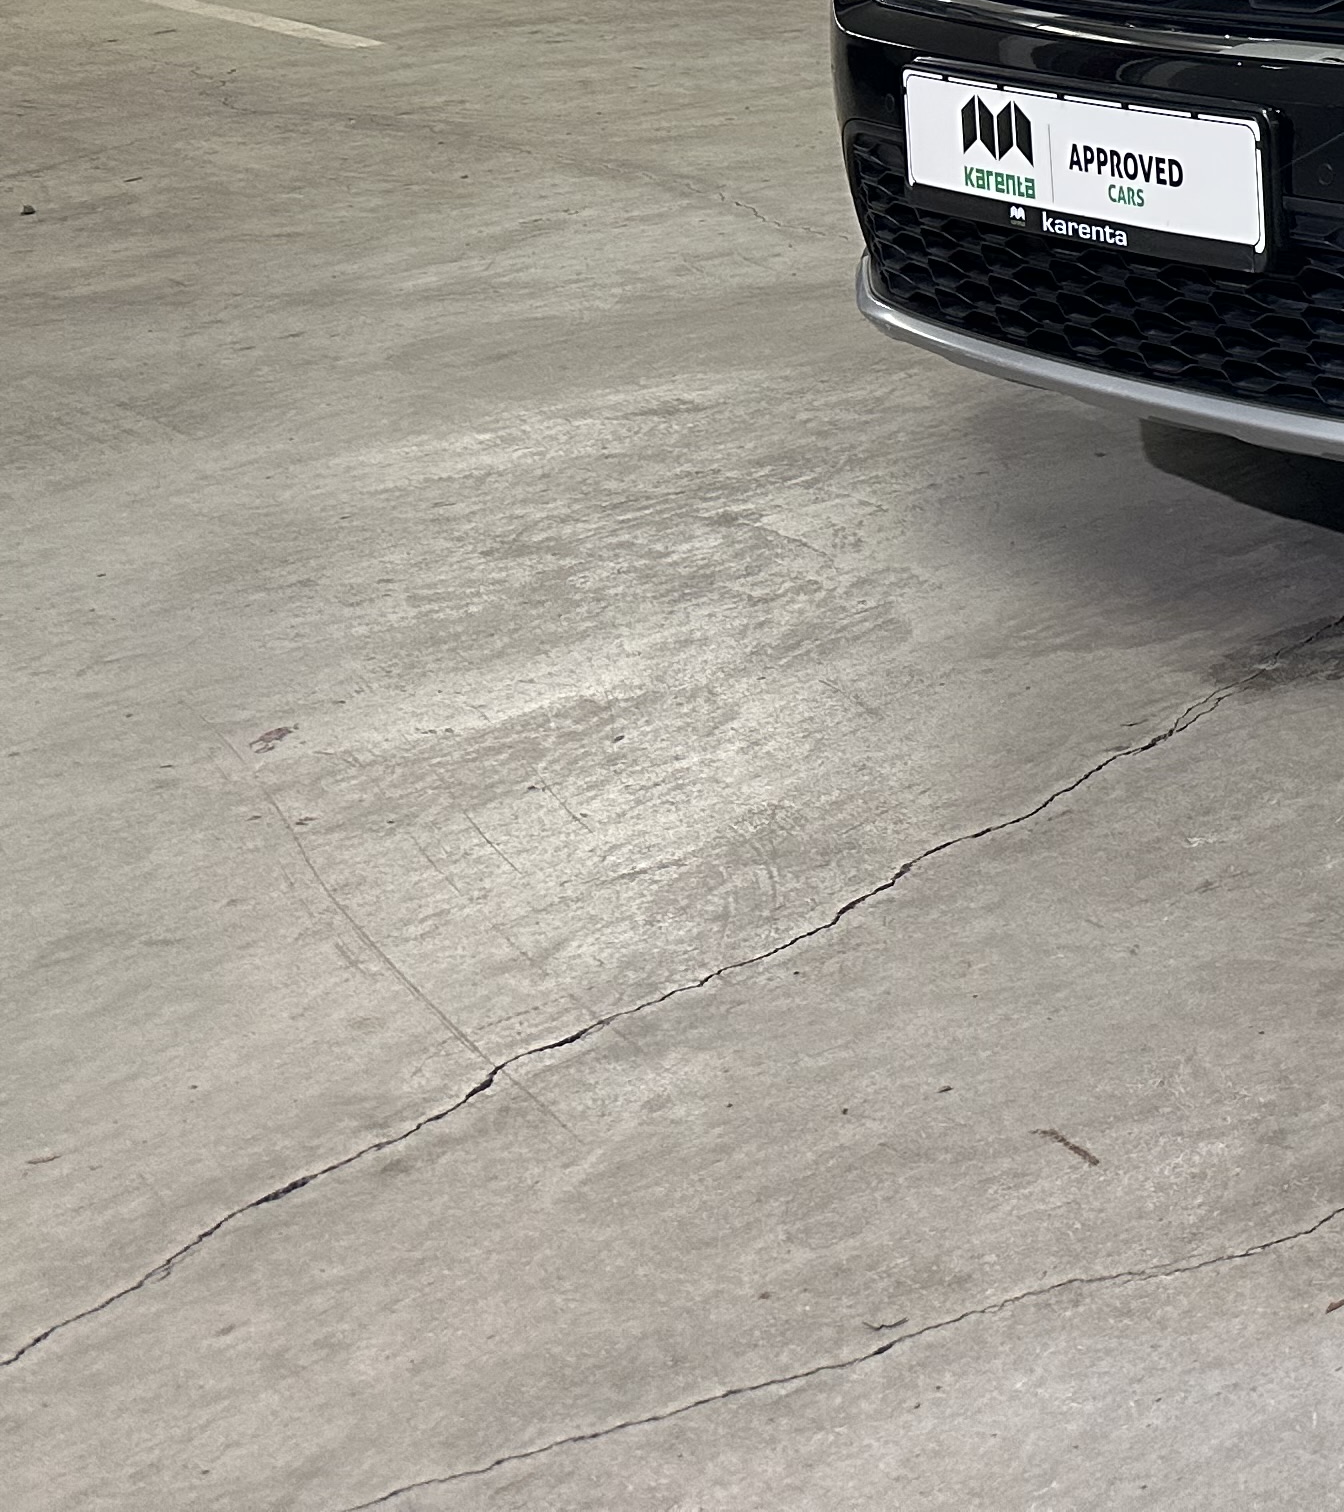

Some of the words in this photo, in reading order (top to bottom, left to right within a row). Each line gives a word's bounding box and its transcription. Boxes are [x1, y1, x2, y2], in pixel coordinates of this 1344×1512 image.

[1069, 143, 1184, 188] APPROVED
[965, 167, 1036, 199] karenta
[1108, 184, 1145, 207] CARS
[1042, 212, 1127, 246] karenta
